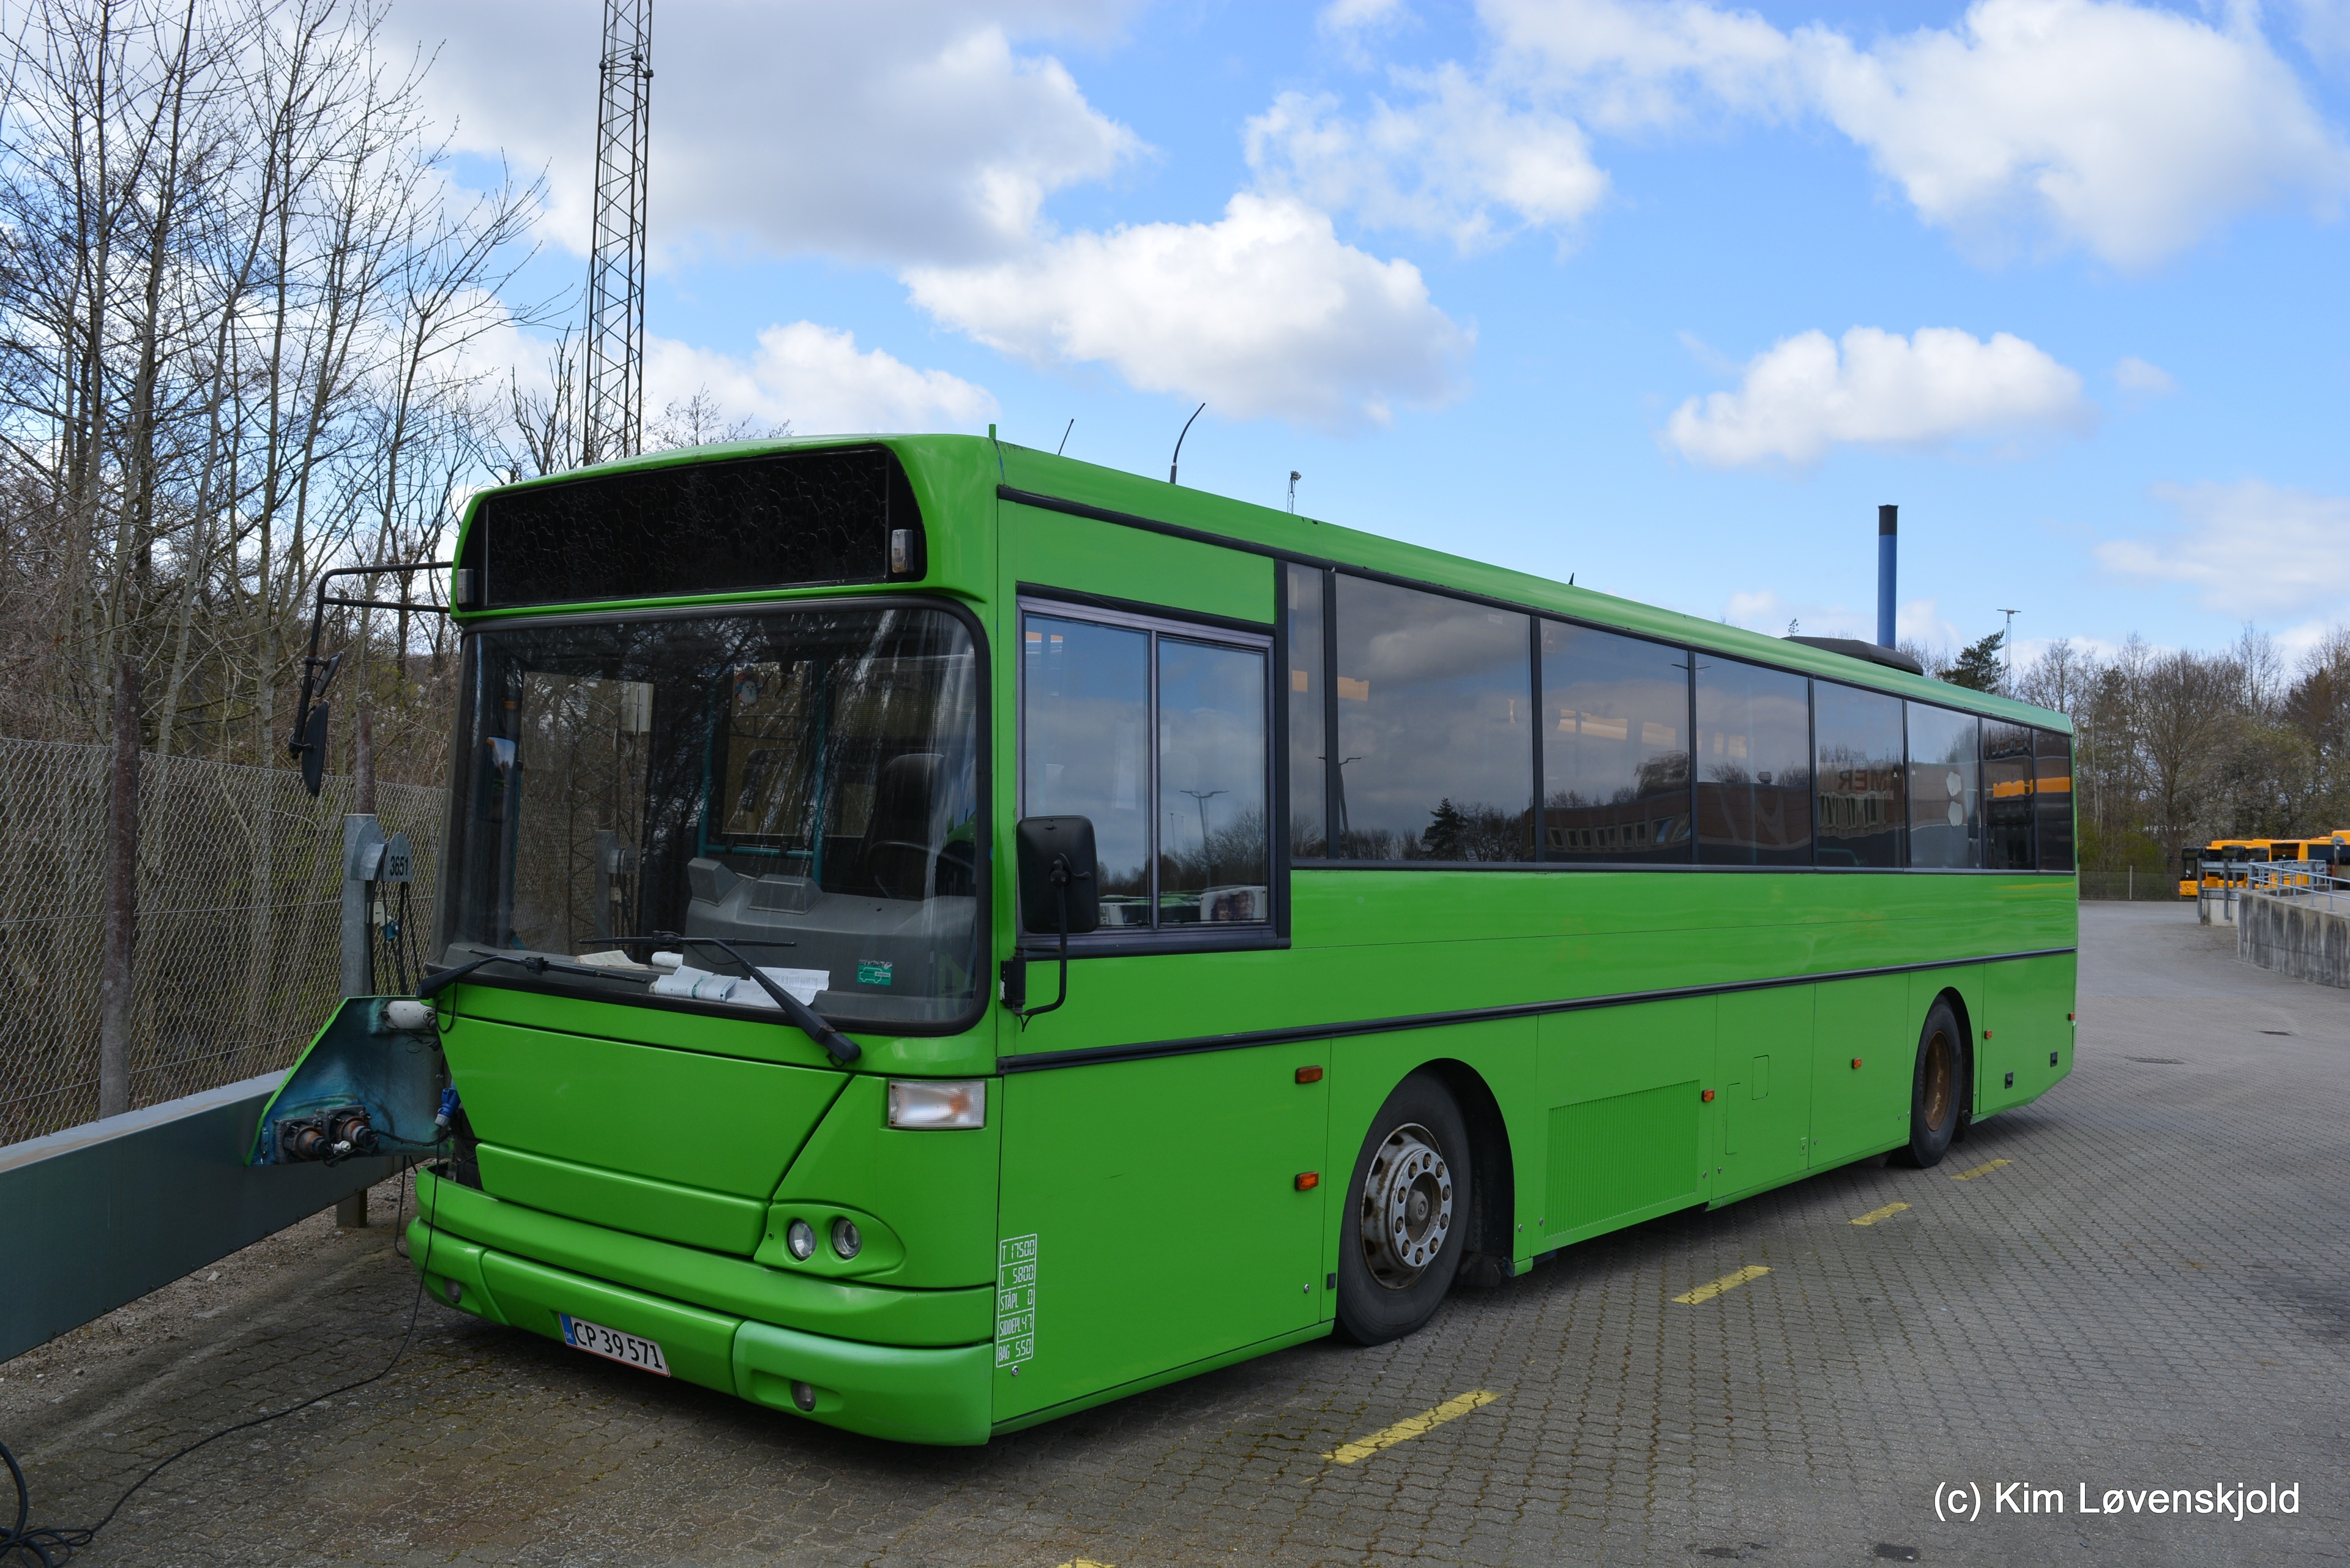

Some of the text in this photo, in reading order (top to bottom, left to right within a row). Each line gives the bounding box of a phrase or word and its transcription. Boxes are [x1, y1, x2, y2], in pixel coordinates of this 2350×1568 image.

[390, 856, 409, 876] 3651
[1002, 1239, 1035, 1261] T 17500
[1001, 1264, 1034, 1286] L 5800
[1000, 1289, 1033, 1311] STÅPL 0
[565, 1332, 573, 1340] DK
[999, 1313, 1032, 1337] SIDDEPL 47
[573, 1322, 663, 1369] CP 39 571
[998, 1338, 1032, 1362] BAG 550
